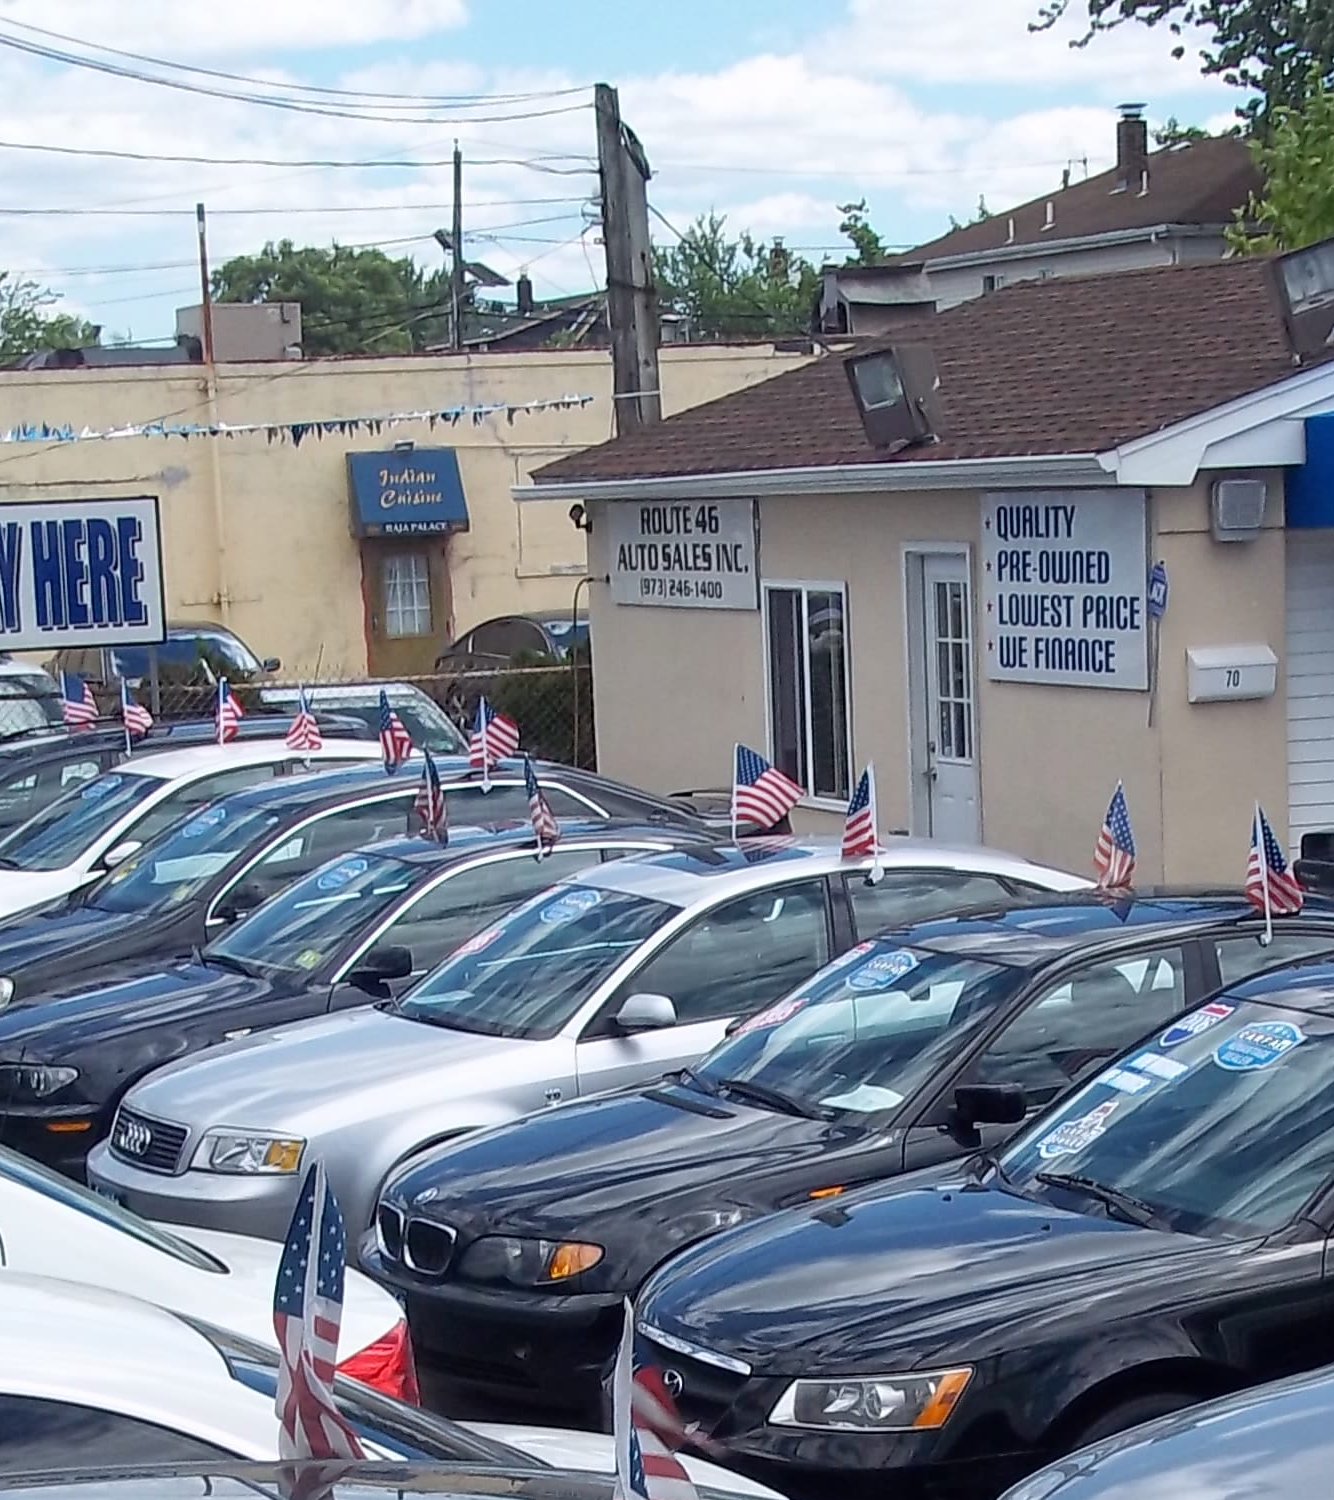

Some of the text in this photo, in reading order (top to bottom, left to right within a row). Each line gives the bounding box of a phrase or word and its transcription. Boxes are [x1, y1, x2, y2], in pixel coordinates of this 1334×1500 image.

[379, 468, 436, 487] Indian
[380, 490, 443, 508] Cuisine
[641, 504, 719, 535] ROUTE 46
[996, 505, 1076, 540] QUALITY
[30, 516, 149, 630] HERE
[618, 543, 749, 574] AUTO SALES INC.
[997, 550, 1110, 585] PRE-OWNED
[640, 578, 722, 599] (973) 246-1400
[998, 593, 1141, 631] LOWEST PRICE
[999, 636, 1116, 674] WE FINANCE
[1225, 669, 1241, 689] 70
